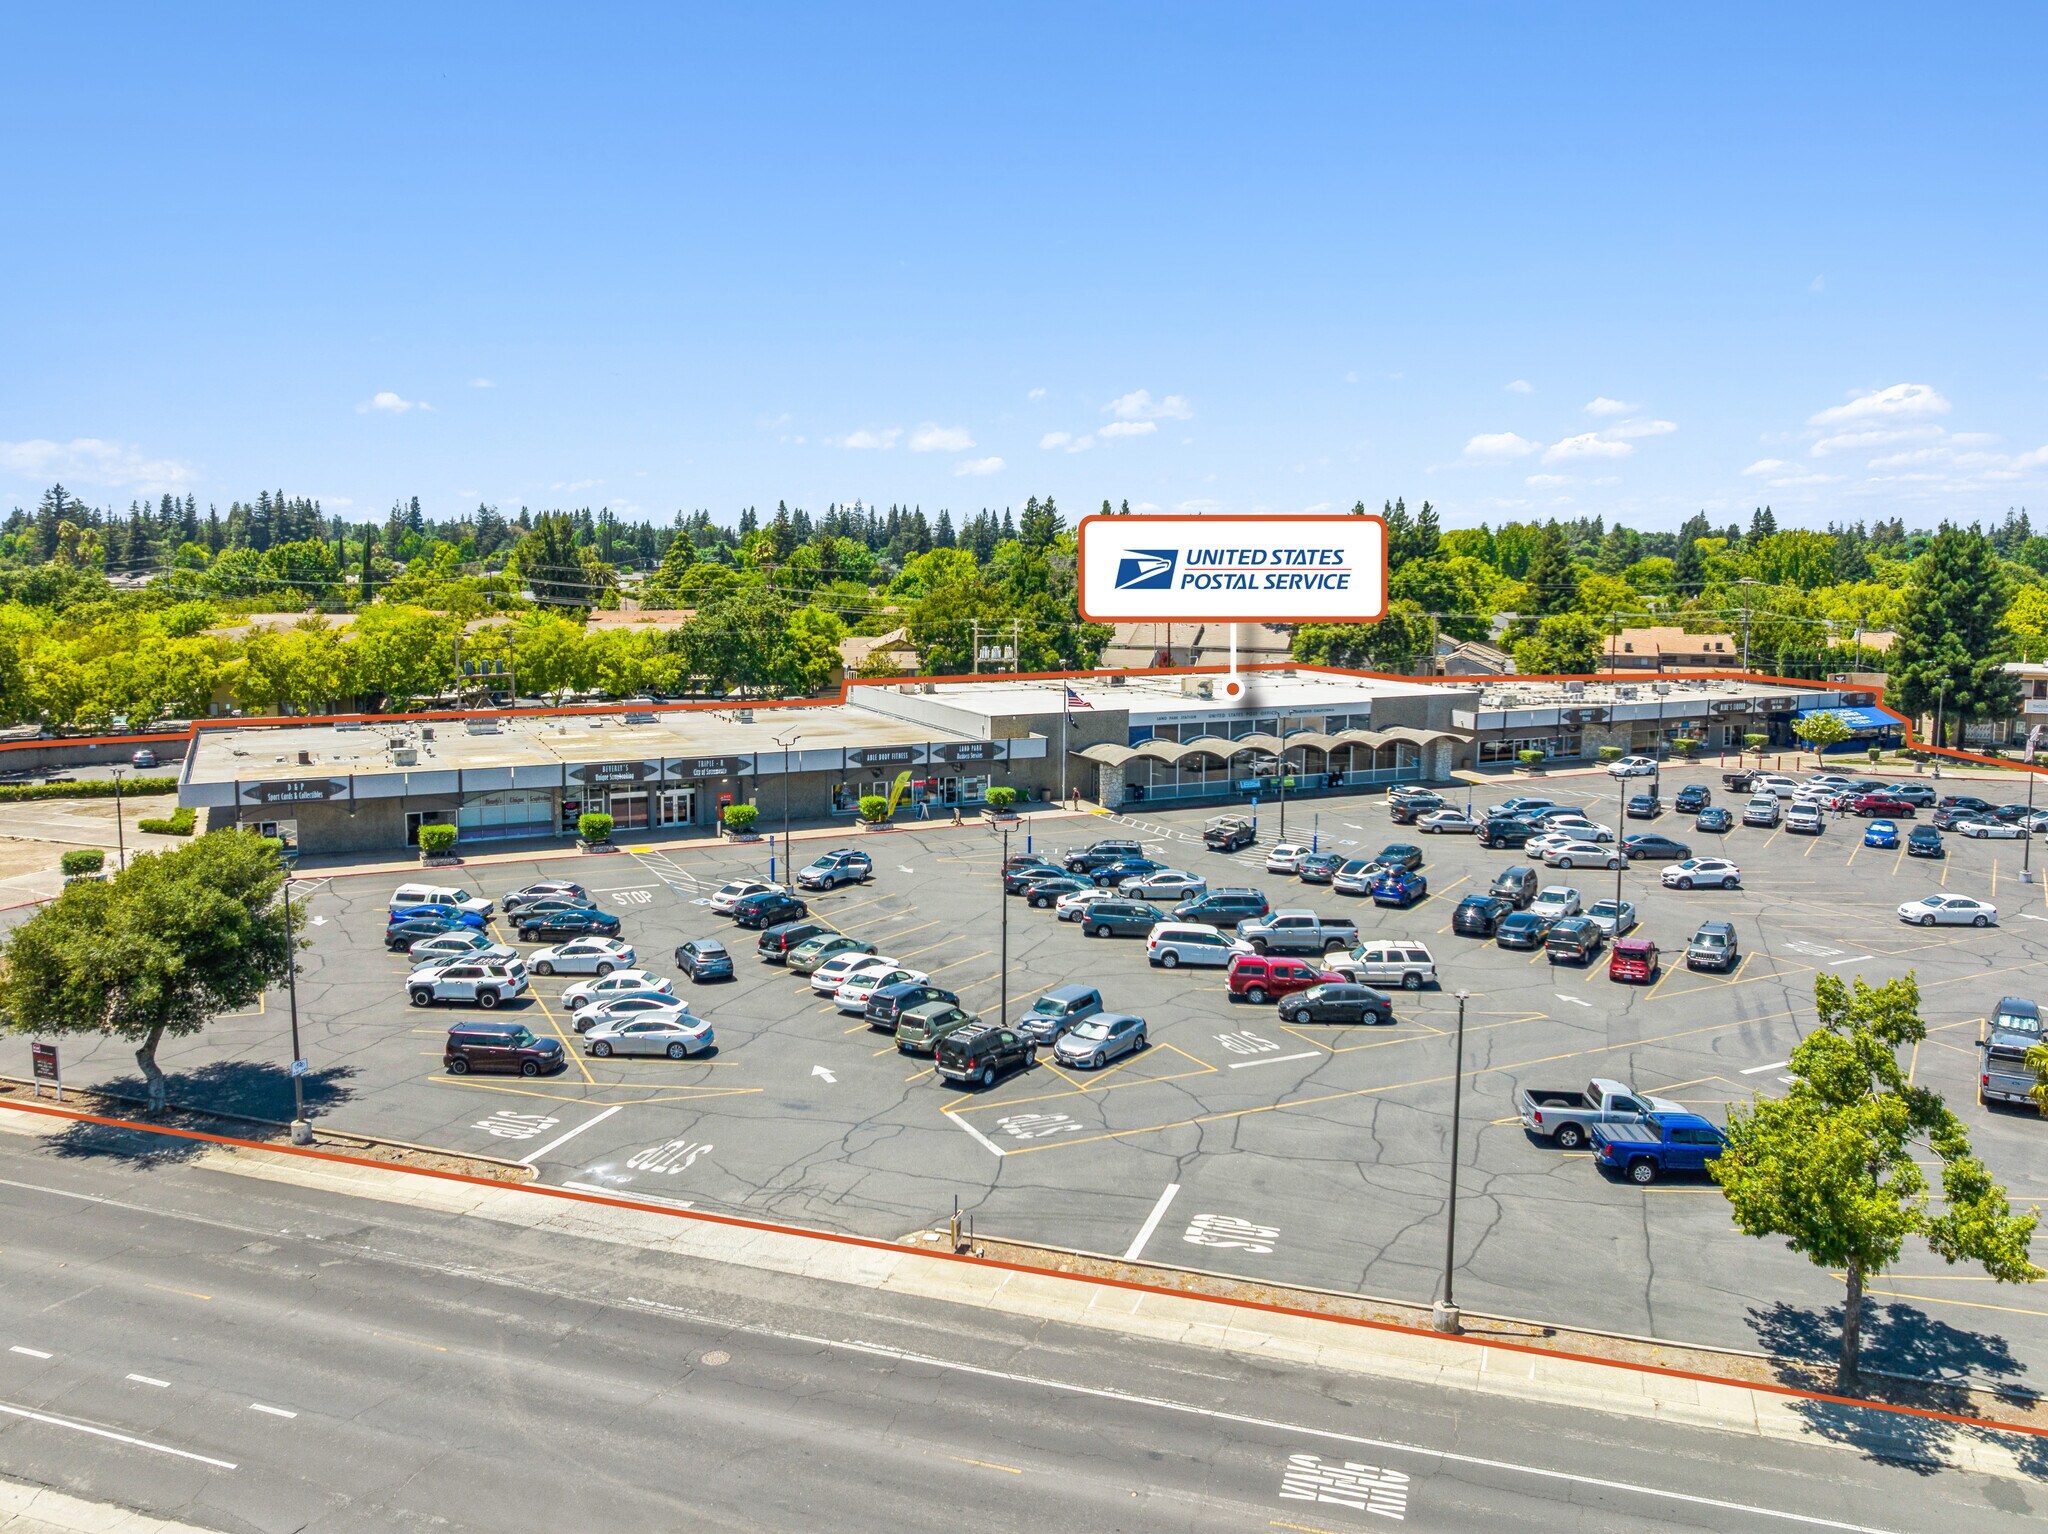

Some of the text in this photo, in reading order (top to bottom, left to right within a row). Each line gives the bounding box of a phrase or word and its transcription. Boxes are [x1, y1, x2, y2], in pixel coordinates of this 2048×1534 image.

[866, 751, 909, 762] ABLE BODY FITNESS
[267, 793, 280, 802] Sport
[281, 792, 293, 800] Cards
[298, 791, 324, 800] Collectibles
[612, 890, 653, 906] STOP
[1212, 1030, 1280, 1055] STOP
[470, 1110, 560, 1140] STOP
[997, 1112, 1083, 1140] STOP
[626, 1139, 713, 1175] STOP
[1182, 1213, 1281, 1254] STOP
[1279, 1454, 1410, 1521] XING
